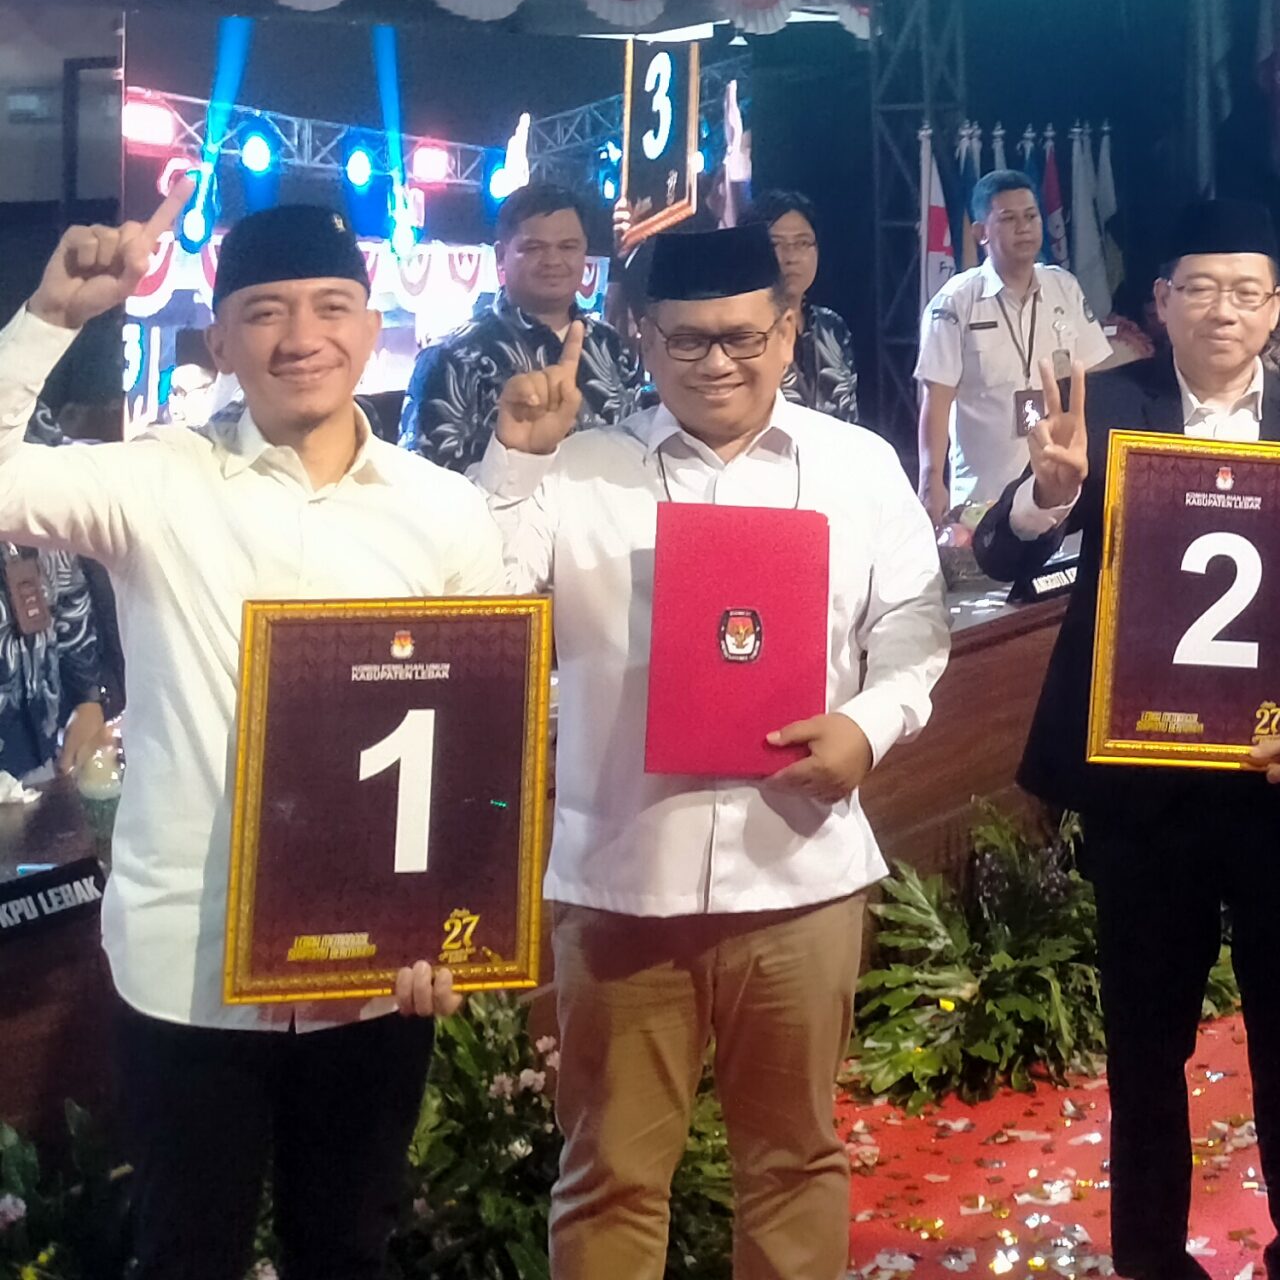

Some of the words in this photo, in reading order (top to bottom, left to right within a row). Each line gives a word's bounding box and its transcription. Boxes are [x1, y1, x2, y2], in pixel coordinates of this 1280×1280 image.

[642, 51, 672, 160] 3
[1172, 531, 1263, 669] 2
[351, 669, 413, 681] KABUPATEN
[358, 708, 437, 874] 1
[0, 895, 39, 928] KPU
[37, 875, 102, 915] LEBAK
[441, 914, 480, 951] 27
